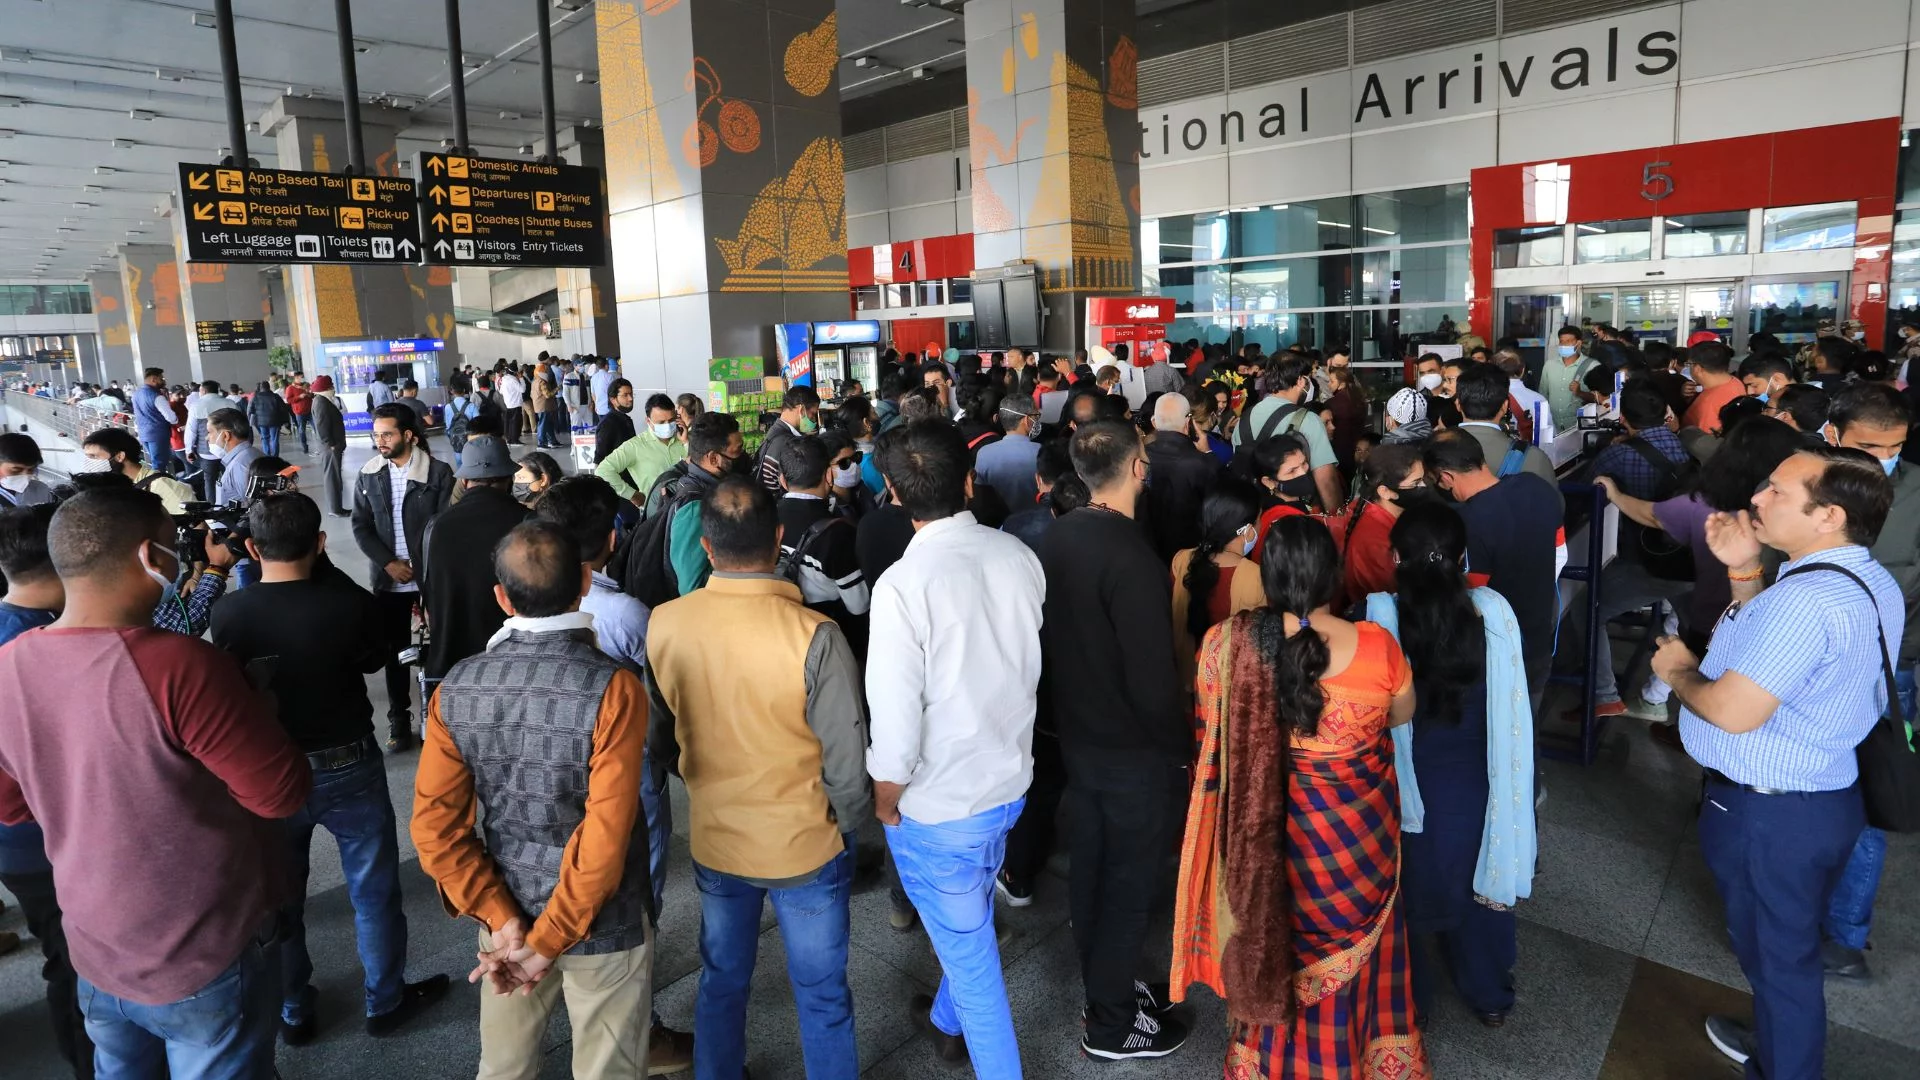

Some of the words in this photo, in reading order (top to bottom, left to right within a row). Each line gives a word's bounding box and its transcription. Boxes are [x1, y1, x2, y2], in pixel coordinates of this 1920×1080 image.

[1354, 27, 1679, 124] Arrivals
[469, 158, 519, 172] Domestic
[521, 163, 559, 175] Arrivals
[248, 172, 274, 186] App
[278, 173, 318, 186] Based
[321, 176, 344, 188] Taxi
[377, 180, 411, 191] Metro
[1641, 161, 1674, 201] 5
[472, 186, 530, 200] Departures
[555, 192, 591, 206] Parking
[250, 202, 301, 217] Prepaid
[305, 204, 330, 217] Taxi
[366, 207, 410, 221] Pick-up
[474, 213, 520, 225] Coaches
[526, 216, 561, 227] Shuttle
[563, 218, 593, 229] Buses
[202, 231, 231, 244] Left
[234, 233, 292, 248] Luggage
[326, 235, 368, 247] Toilets
[476, 239, 516, 251] Visitors
[522, 241, 548, 253] Entry
[550, 241, 584, 252] Tickets
[221, 247, 253, 257] अमानती
[898, 251, 912, 273] 4
